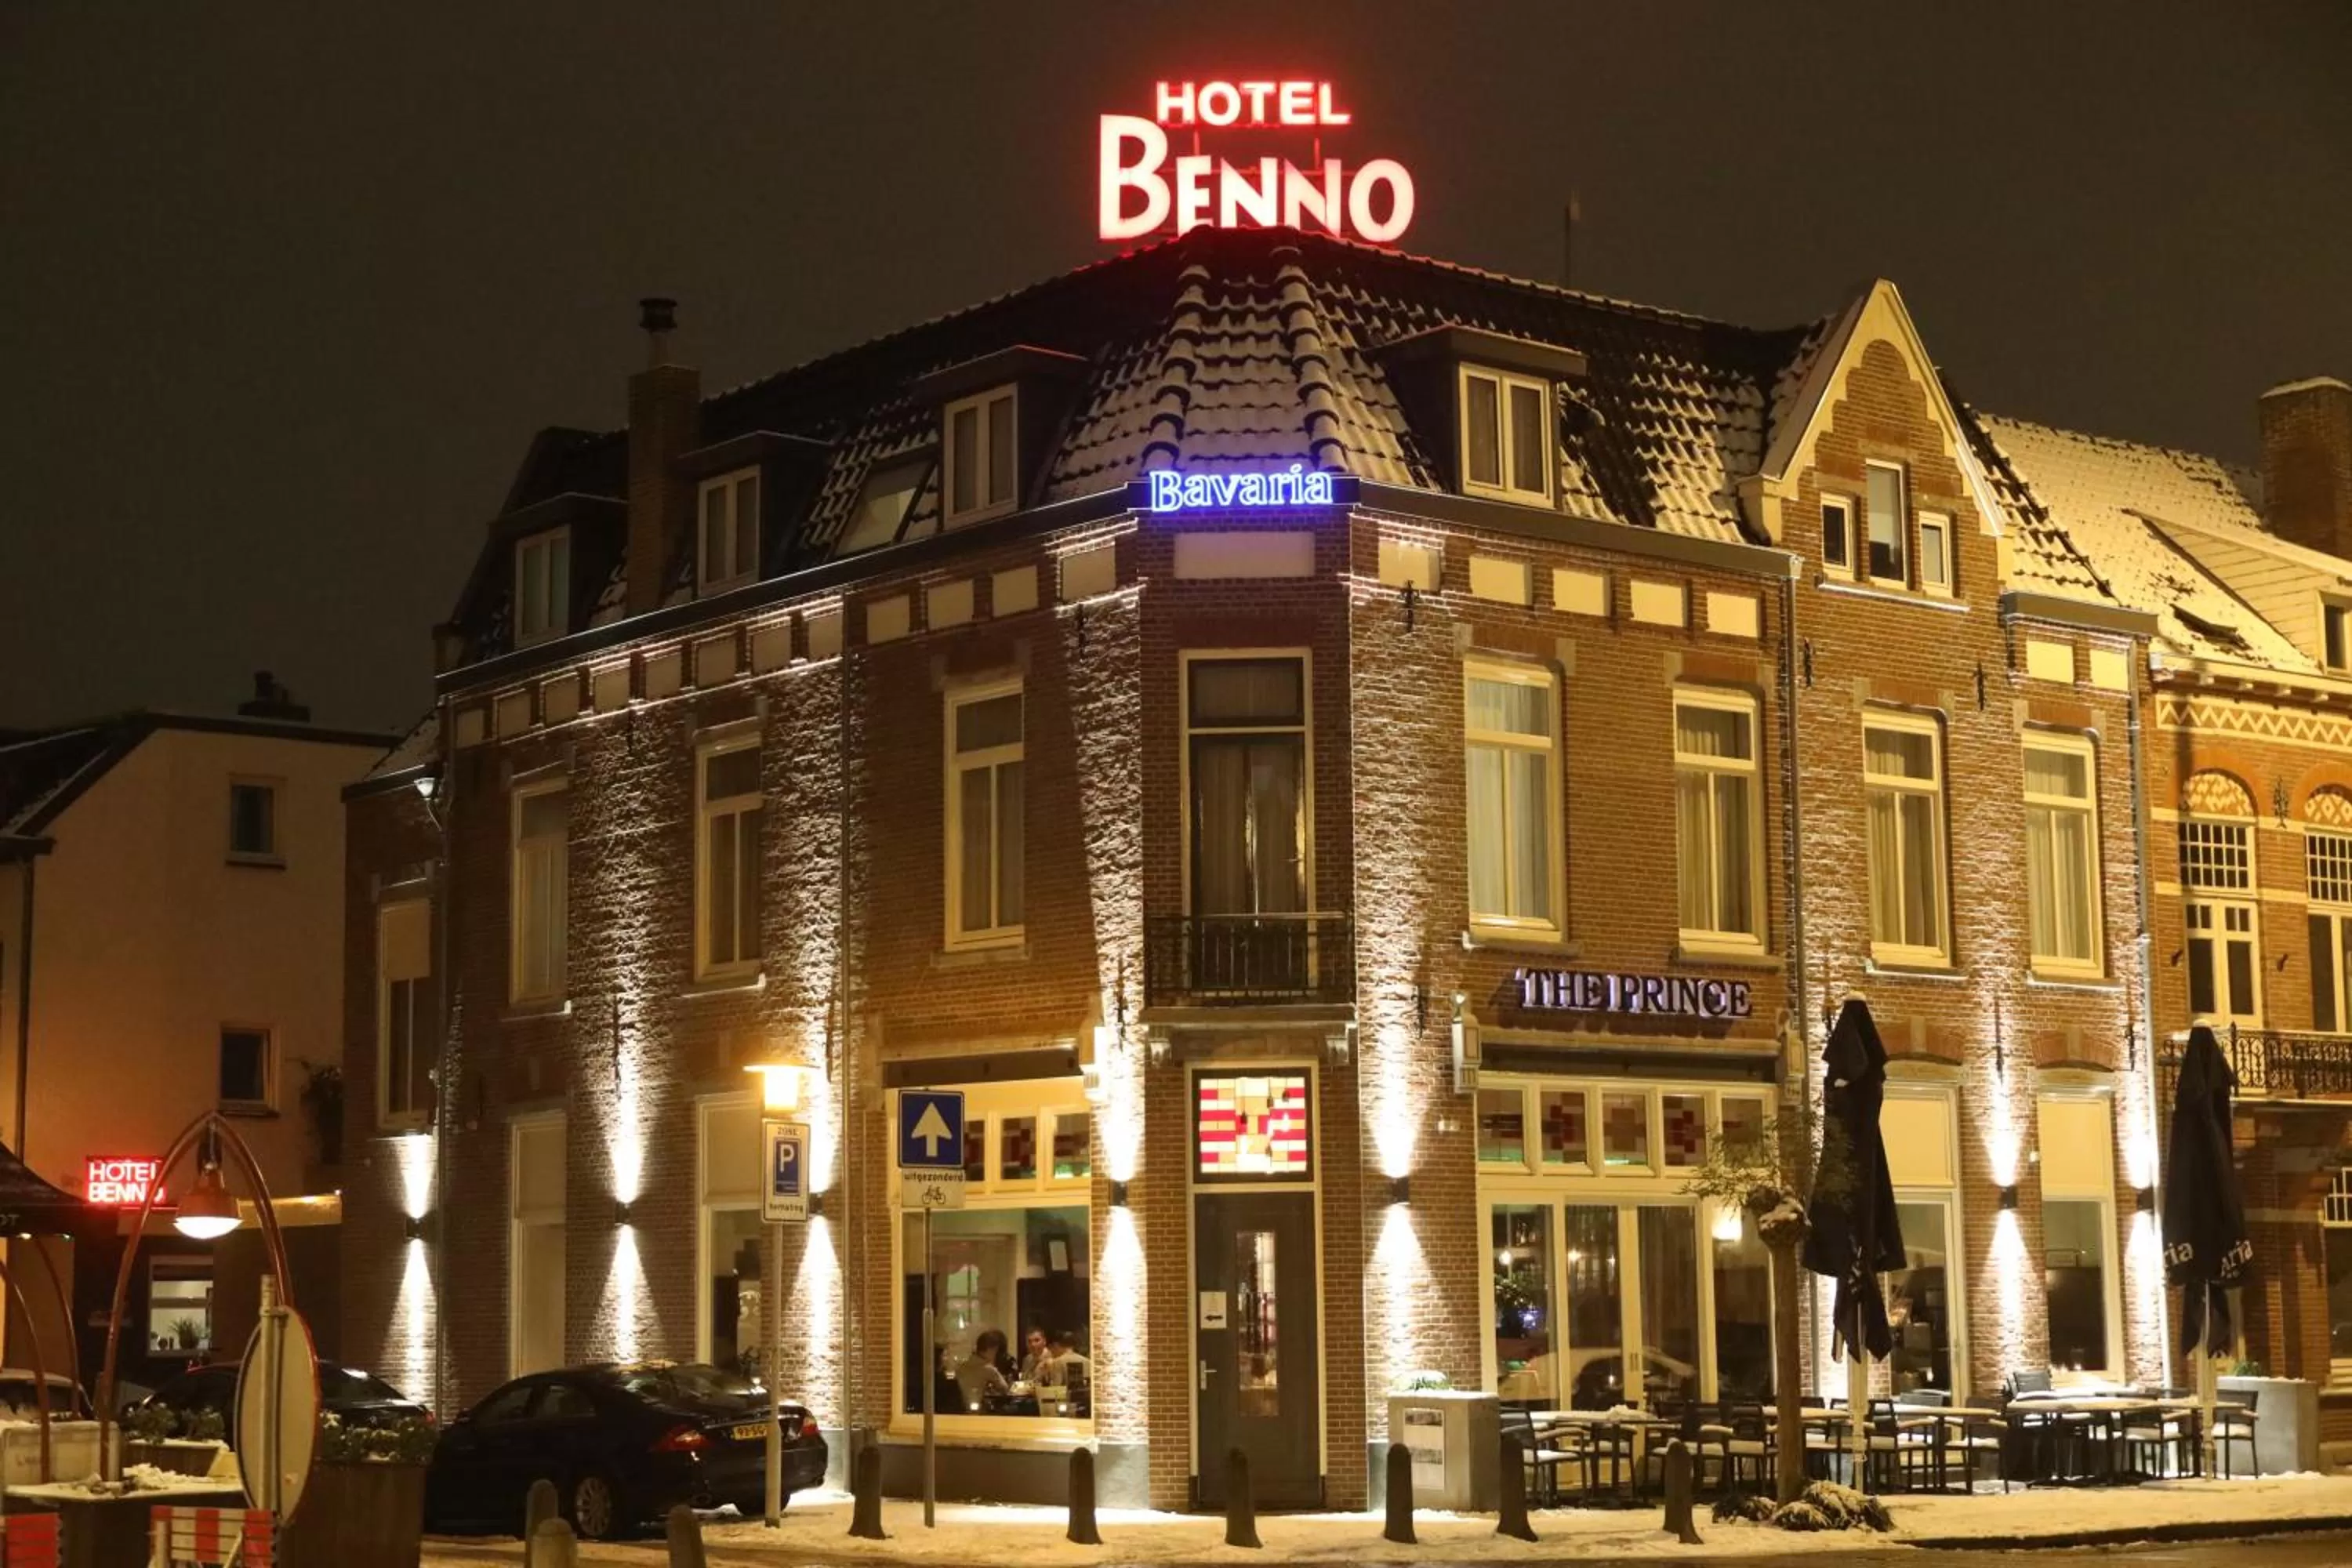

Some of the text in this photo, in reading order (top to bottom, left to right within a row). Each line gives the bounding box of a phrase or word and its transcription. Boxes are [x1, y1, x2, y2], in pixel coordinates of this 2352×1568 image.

[1156, 81, 1352, 127] HOTEL
[1099, 114, 1414, 242] BENNO
[1150, 463, 1334, 512] Bavaria
[1515, 967, 1754, 1018] THE PRINCE
[779, 1143, 795, 1173] P
[904, 1171, 964, 1183] uitgezonderd
[88, 1181, 164, 1203] BENN
